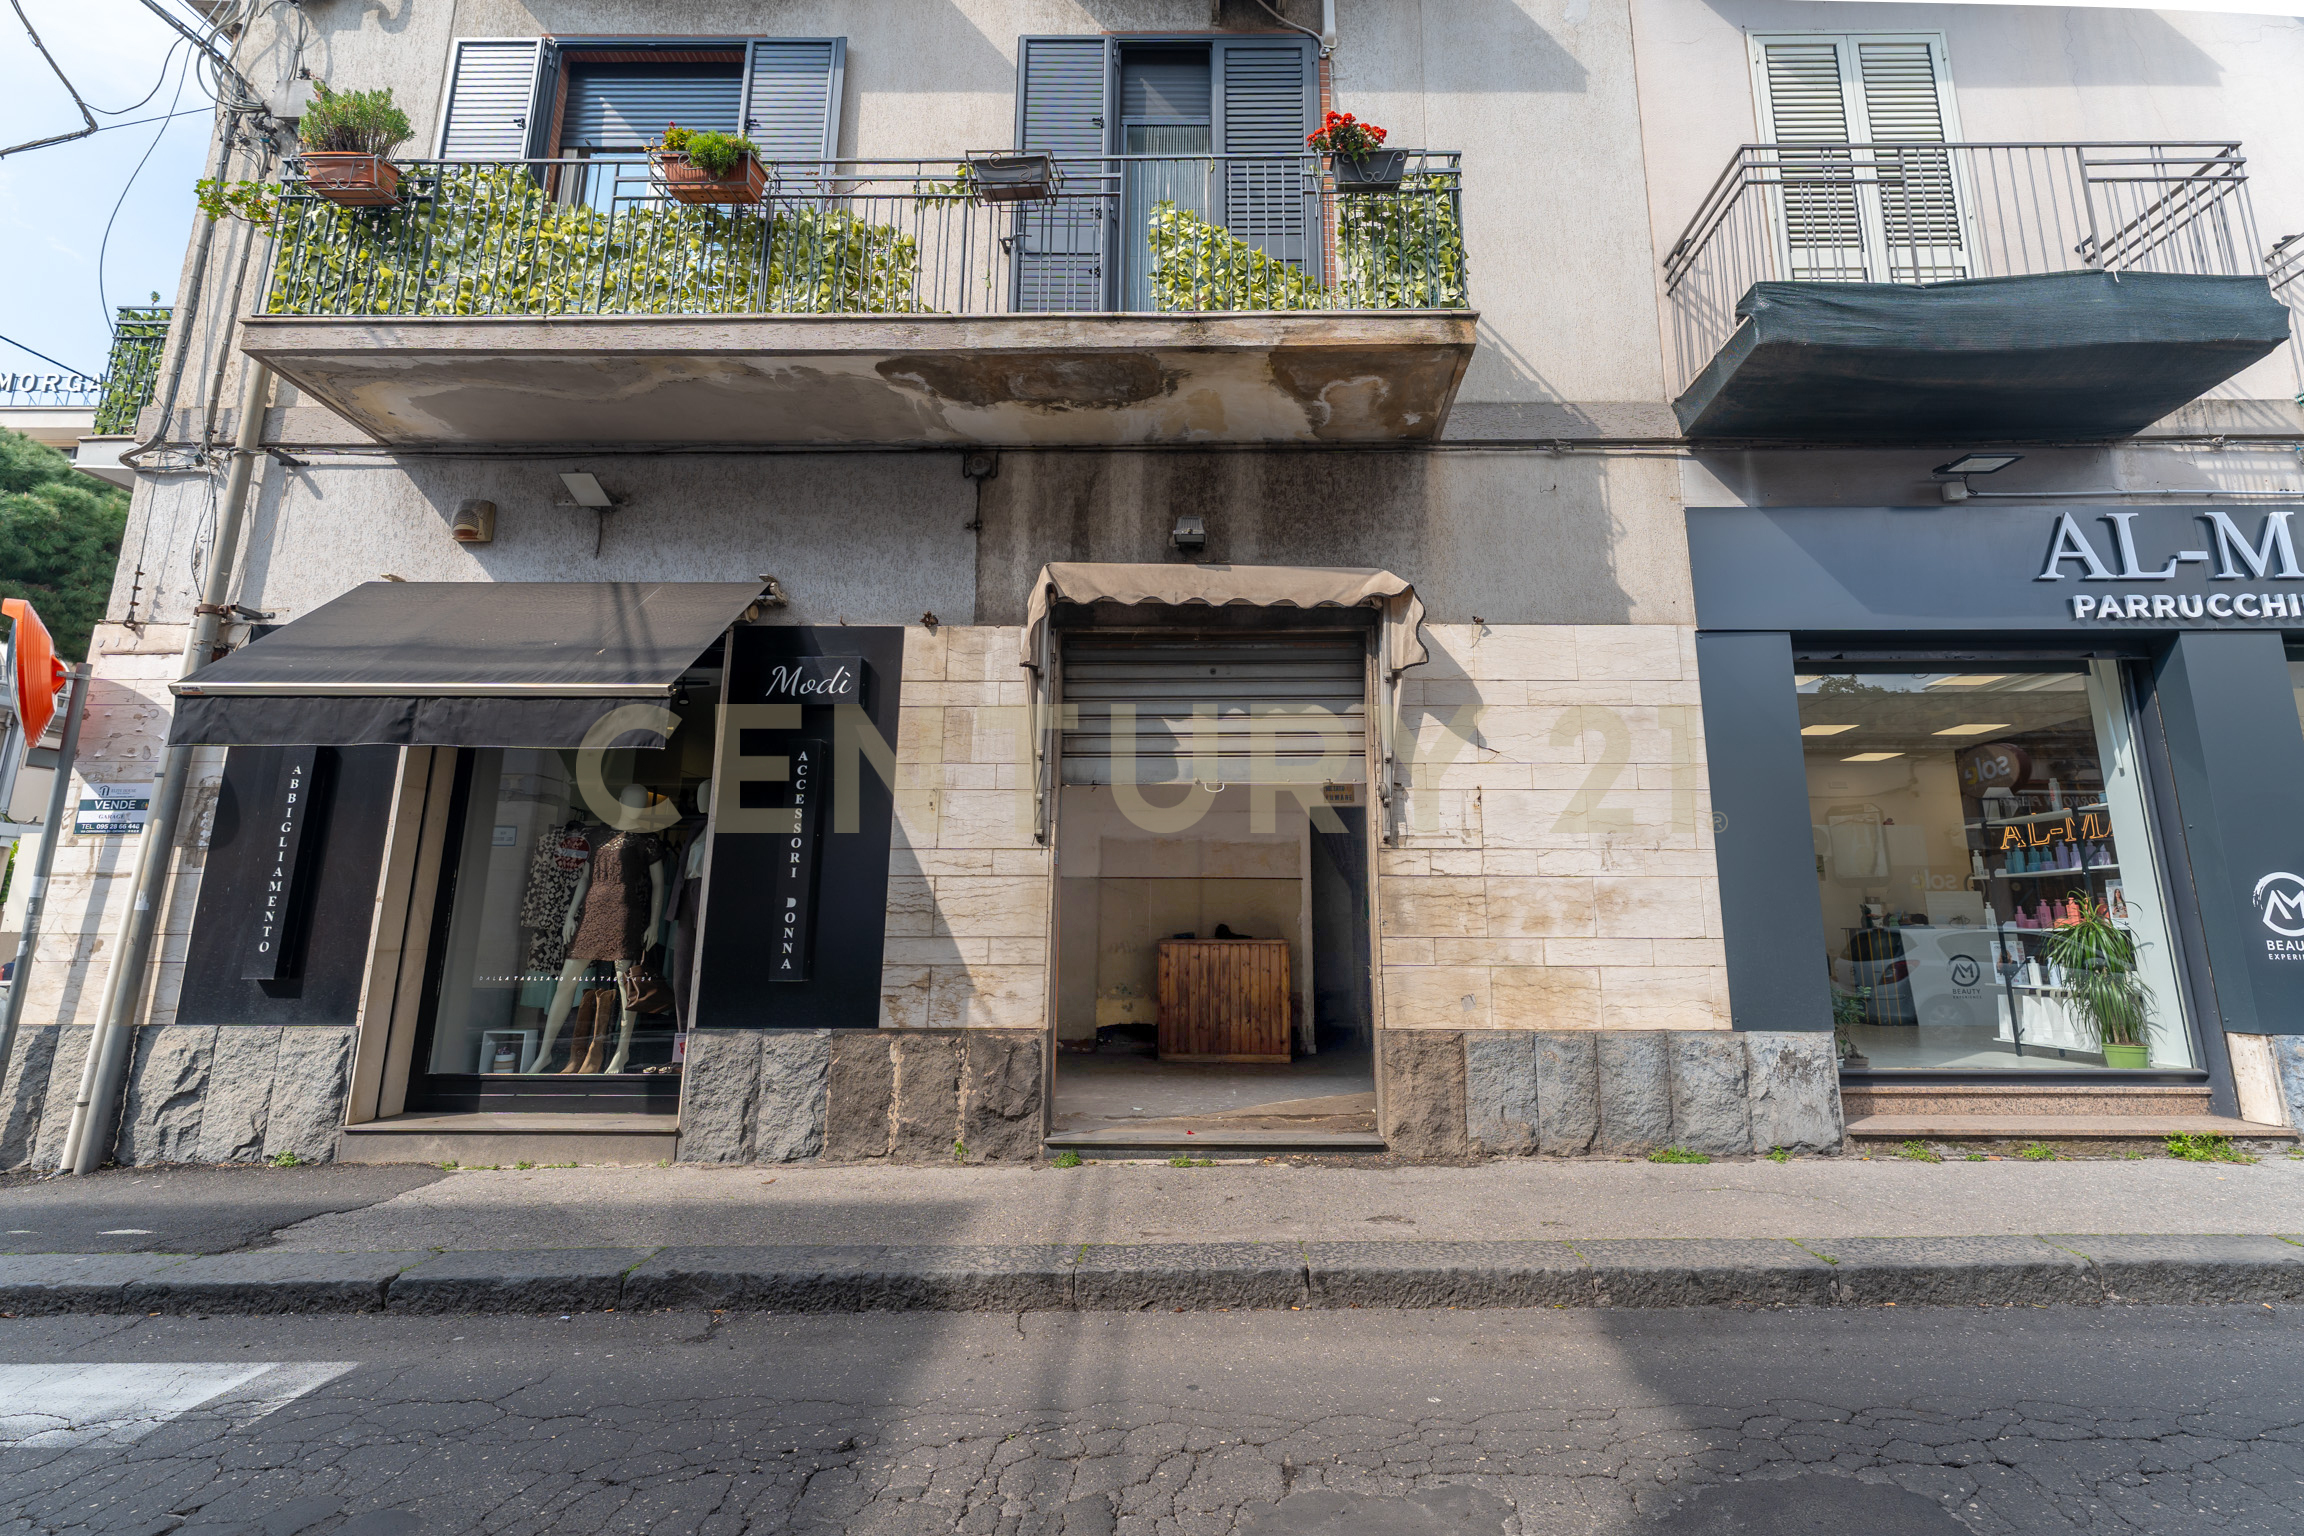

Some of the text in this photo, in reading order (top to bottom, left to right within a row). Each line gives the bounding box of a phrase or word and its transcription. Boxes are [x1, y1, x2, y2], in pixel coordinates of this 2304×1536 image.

[2039, 511, 2304, 580] AL-M
[2073, 593, 2304, 619] PARRUCCHI
[766, 665, 852, 697] Modì
[94, 800, 137, 809] VENDE
[258, 765, 302, 953] ABBIGLIAMENTO
[781, 751, 808, 970] ACCESSORI DONNA
